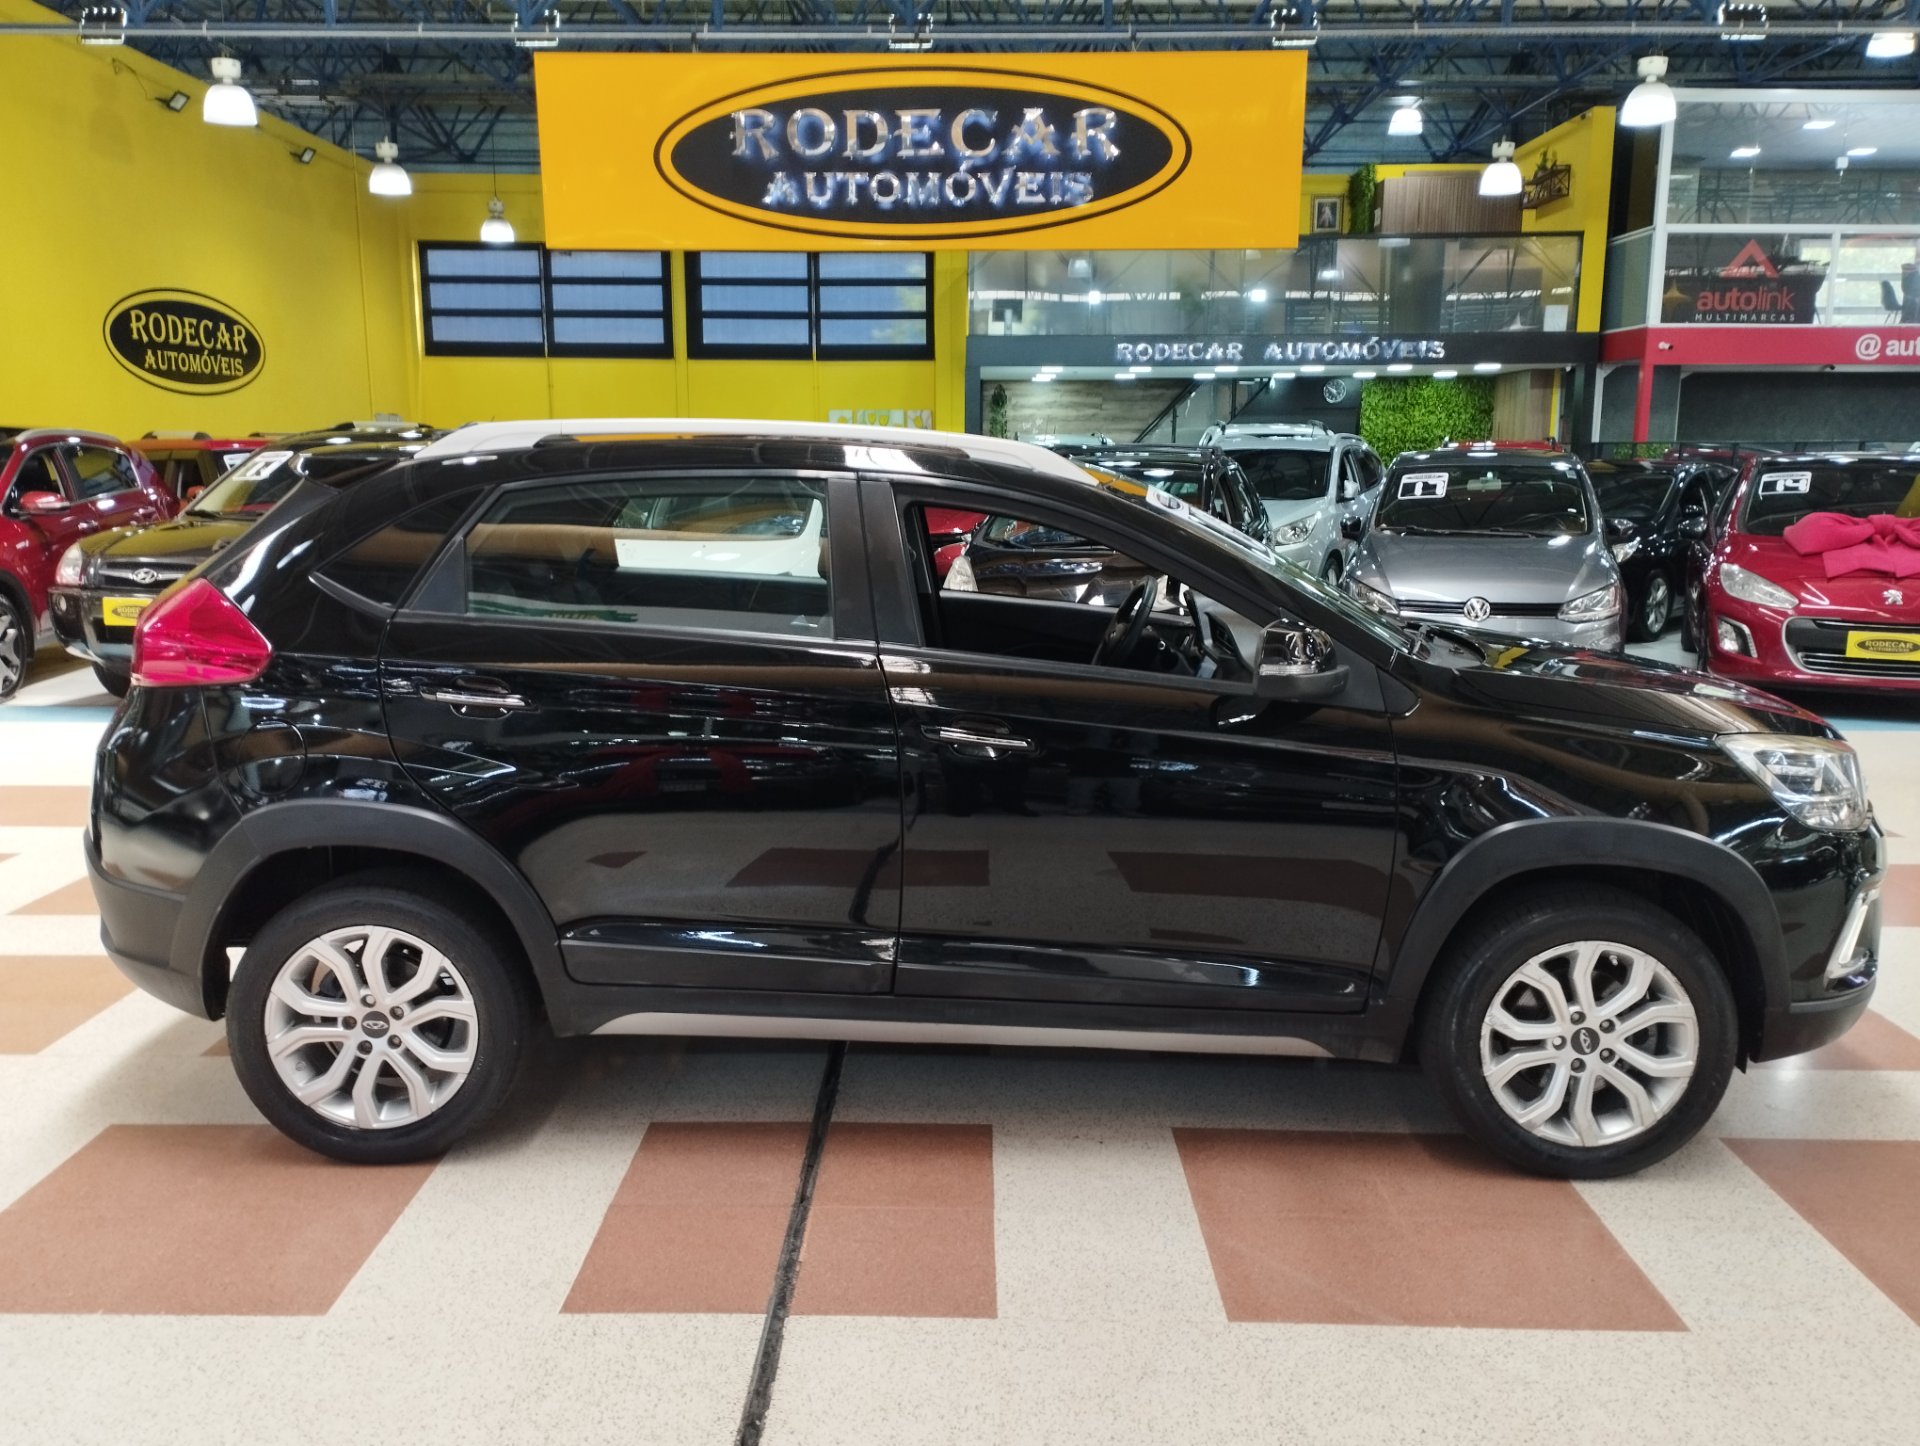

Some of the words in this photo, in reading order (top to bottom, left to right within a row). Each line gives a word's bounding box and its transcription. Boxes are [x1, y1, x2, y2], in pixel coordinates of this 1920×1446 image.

[729, 107, 1121, 160] RODECAR
[762, 160, 1096, 206] AUTOMÓVEIS
[1696, 286, 1796, 312] autolink
[1695, 313, 1796, 322] MULTIMARCAS
[129, 309, 248, 356] RODECAR
[1117, 342, 1244, 362] RODECAR
[1264, 337, 1446, 361] AUTOMÓVEIS
[144, 349, 245, 377] AUTOMÓVEIS
[1414, 480, 1445, 496] 17
[1776, 479, 1807, 493] 14
